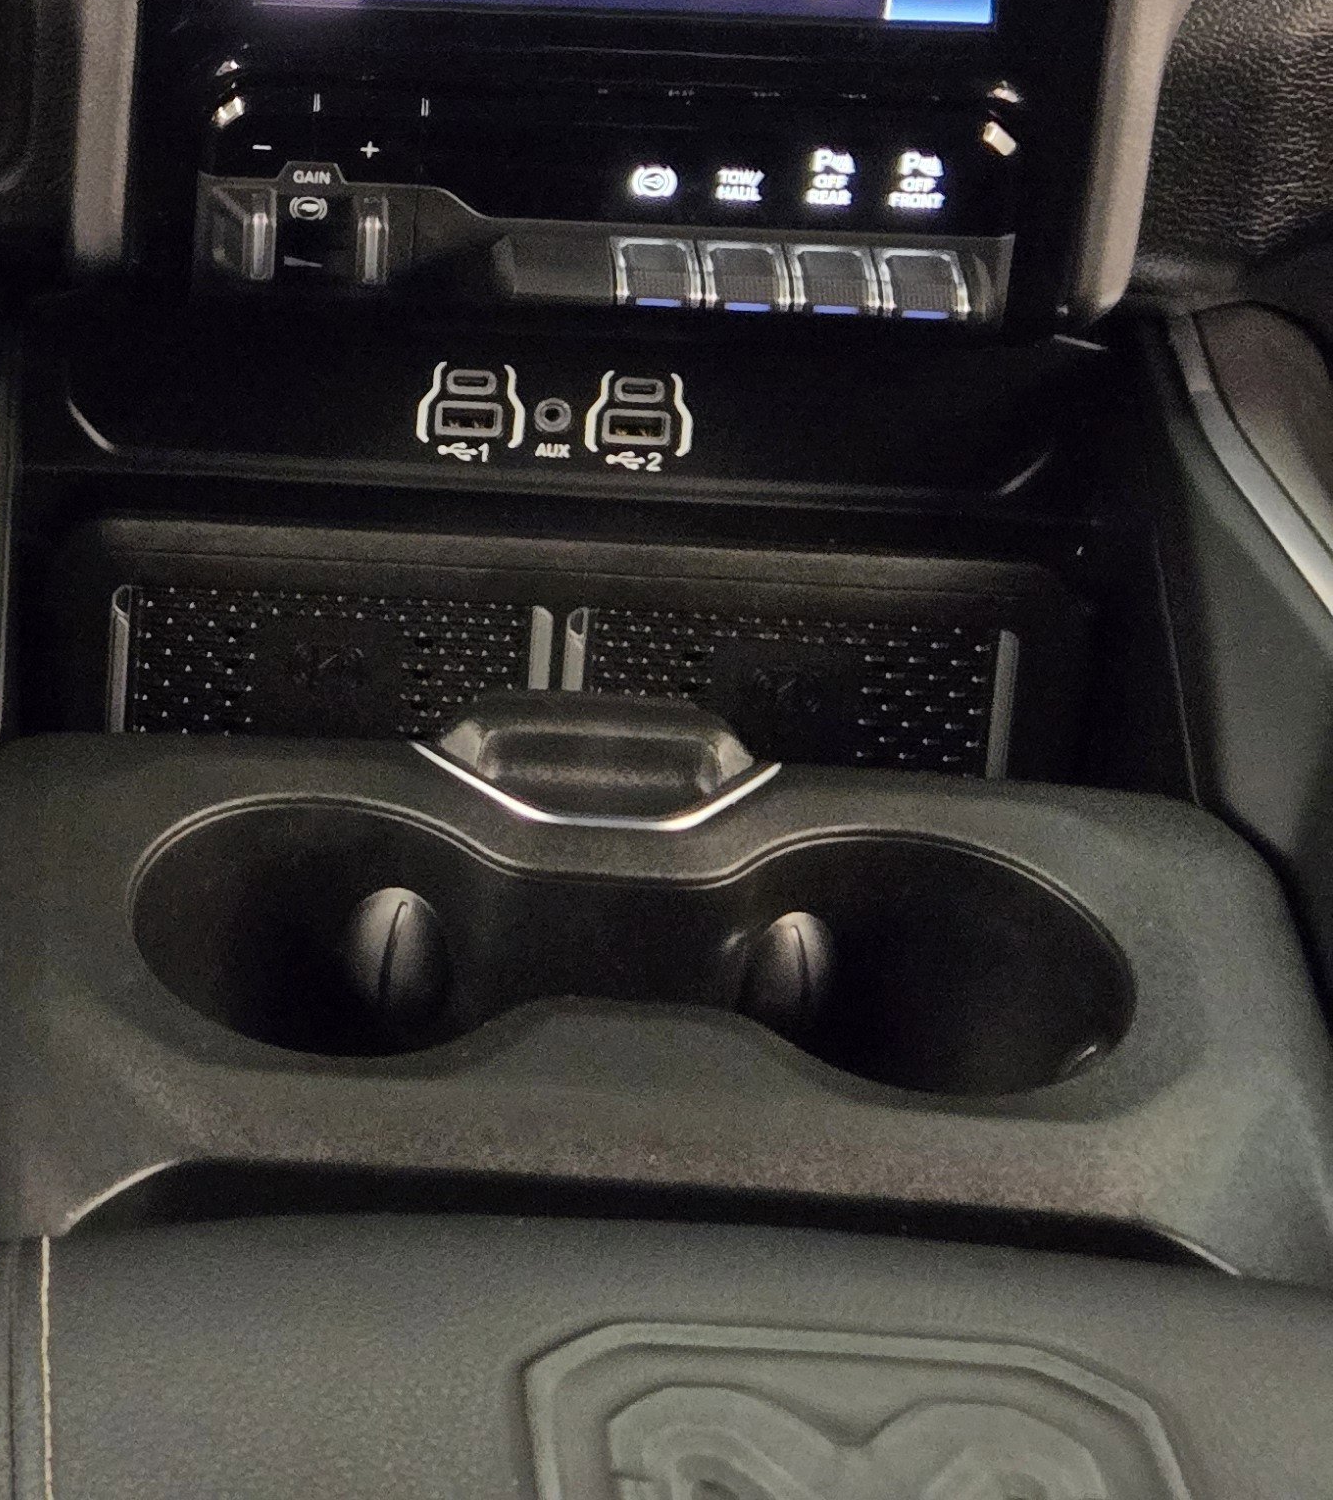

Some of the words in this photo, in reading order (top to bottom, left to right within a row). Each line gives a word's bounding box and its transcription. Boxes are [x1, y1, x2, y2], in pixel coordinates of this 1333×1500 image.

[292, 169, 331, 185] GAIN
[814, 174, 848, 190] OFF
[899, 176, 937, 192] OFF
[715, 185, 763, 202] HAUL
[804, 189, 852, 206] REAR
[888, 191, 946, 209] FRONT
[535, 443, 571, 459] AUX
[645, 452, 663, 472] 2
